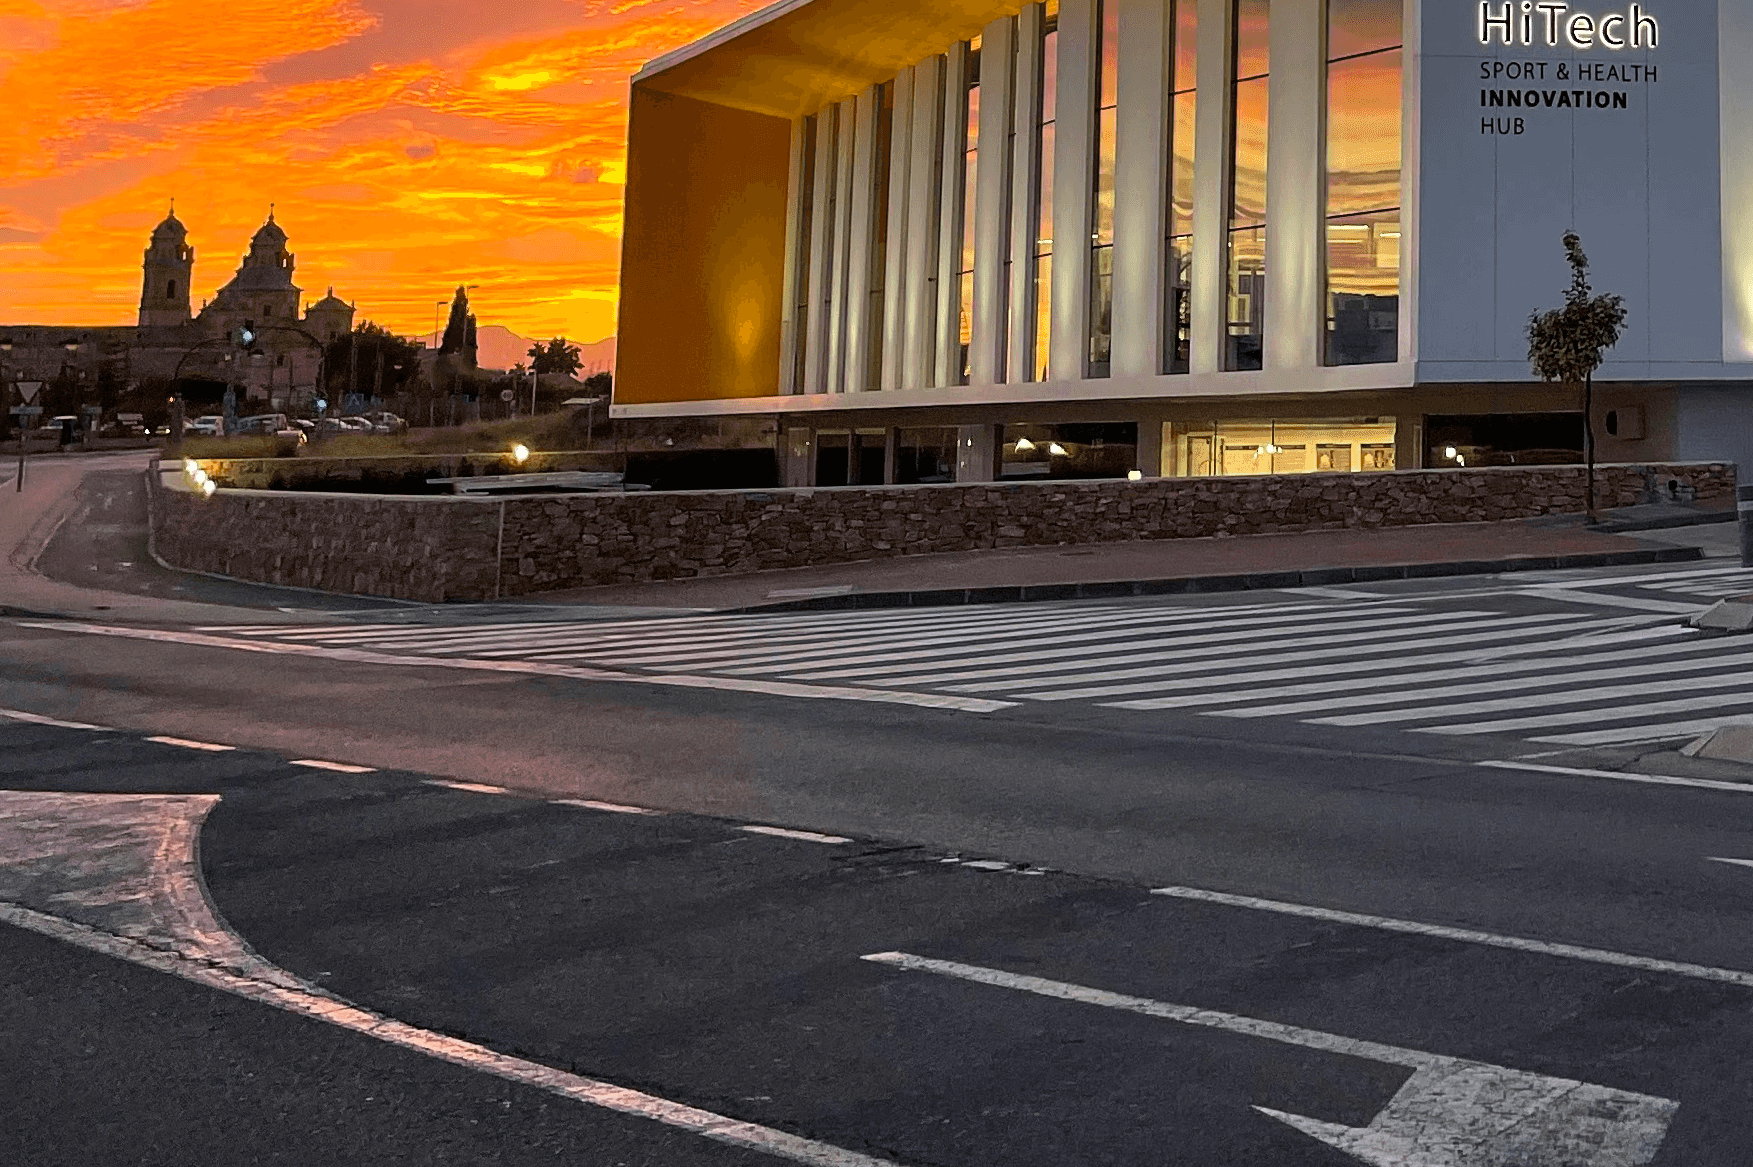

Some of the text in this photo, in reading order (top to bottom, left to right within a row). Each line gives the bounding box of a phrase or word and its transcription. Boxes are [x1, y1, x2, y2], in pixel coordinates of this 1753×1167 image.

[1481, 1, 1658, 47] HiTech
[1480, 62, 1657, 82] SPORT & HEALTH
[1480, 89, 1627, 109] INNOVATION
[1481, 117, 1525, 135] HUB
